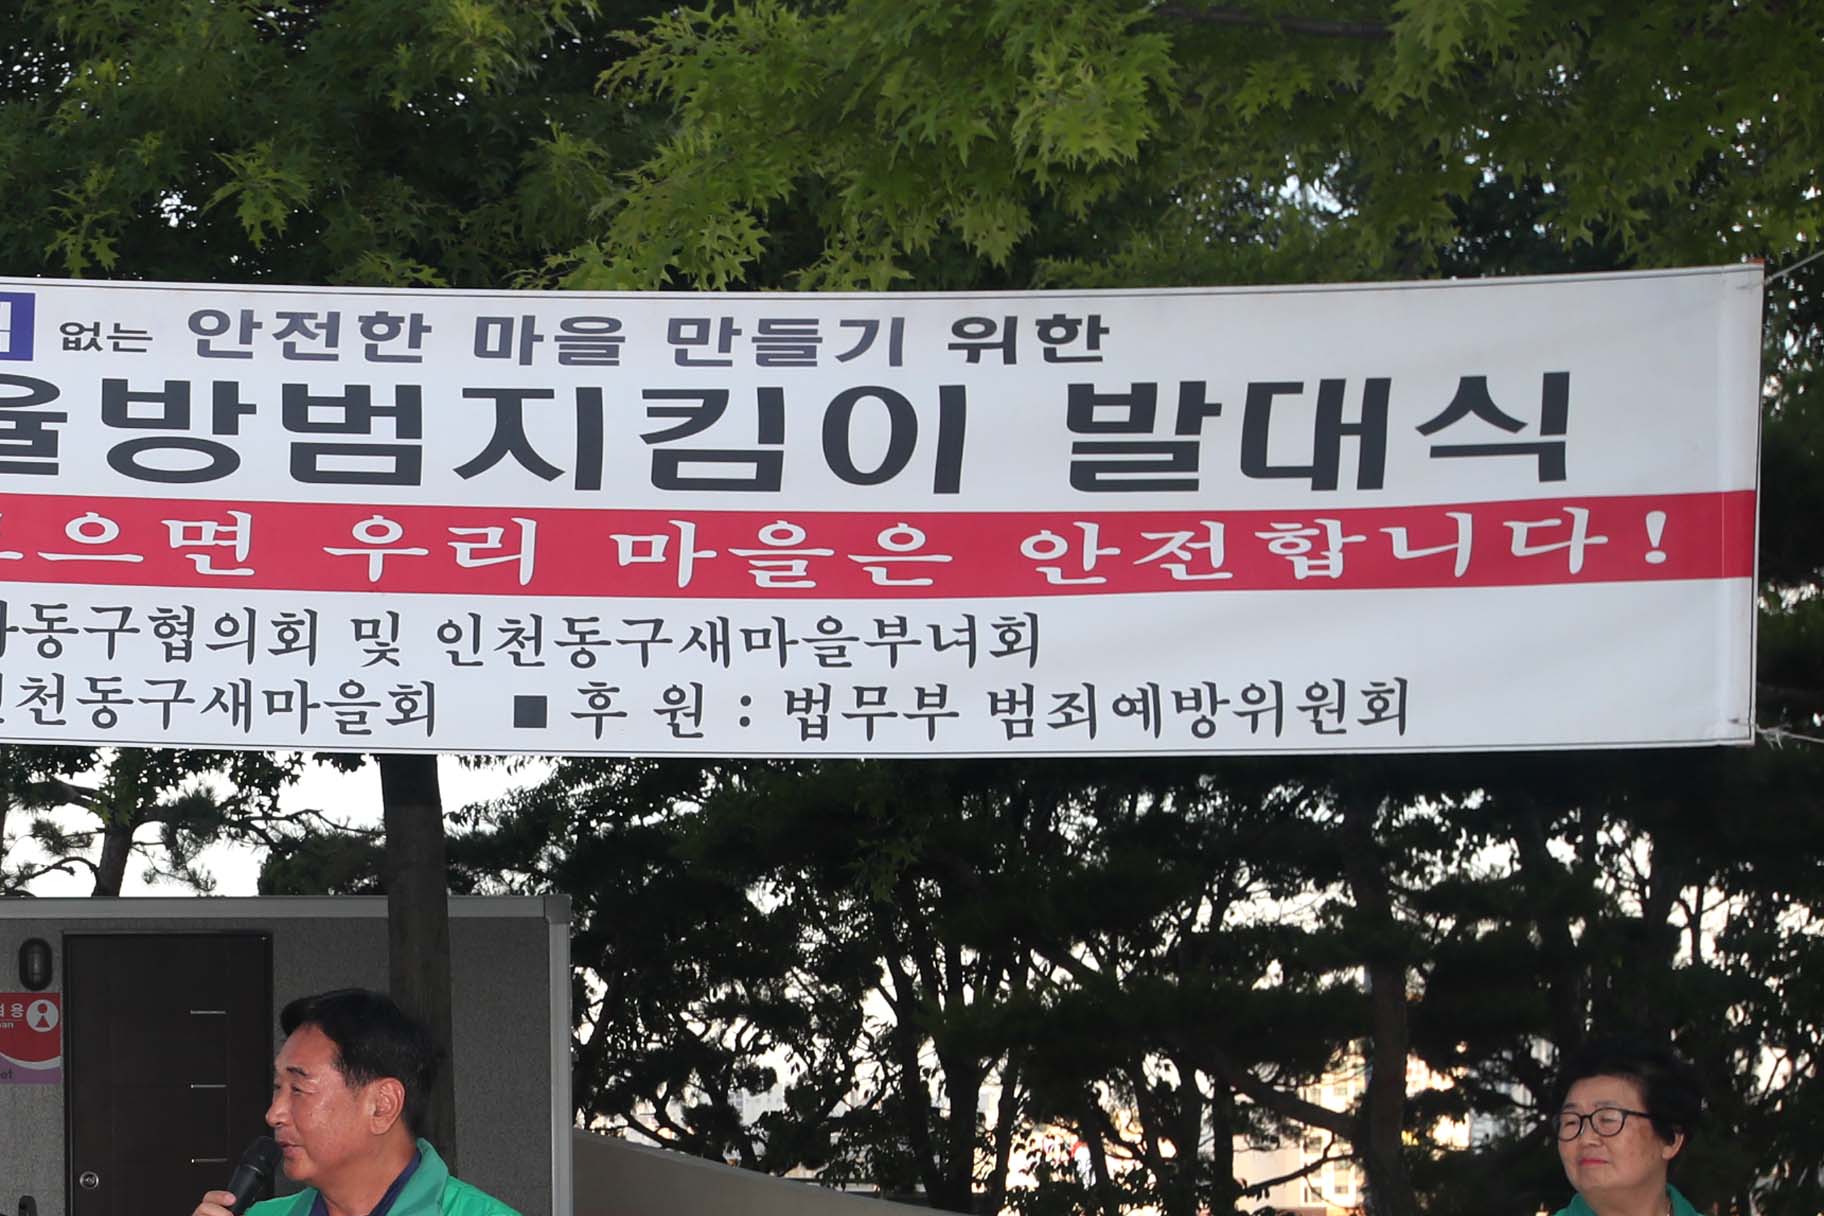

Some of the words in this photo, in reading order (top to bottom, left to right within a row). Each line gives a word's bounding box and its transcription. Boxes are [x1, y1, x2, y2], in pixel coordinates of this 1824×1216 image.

[59, 321, 153, 353] 없는
[187, 309, 433, 364] 안전한
[473, 314, 626, 367] 마을
[667, 316, 905, 368] 만들기
[947, 313, 1110, 366] 위한
[1066, 370, 1571, 493] 발대식
[323, 514, 537, 586] 우리
[609, 519, 953, 588] 마을은
[1020, 507, 1666, 585] 안전합니다!
[350, 610, 400, 668] 및
[436, 611, 1039, 669] 인천동구새마을부녀회
[783, 682, 960, 742] 법무부
[987, 676, 1408, 741] 범죄예방위원회
